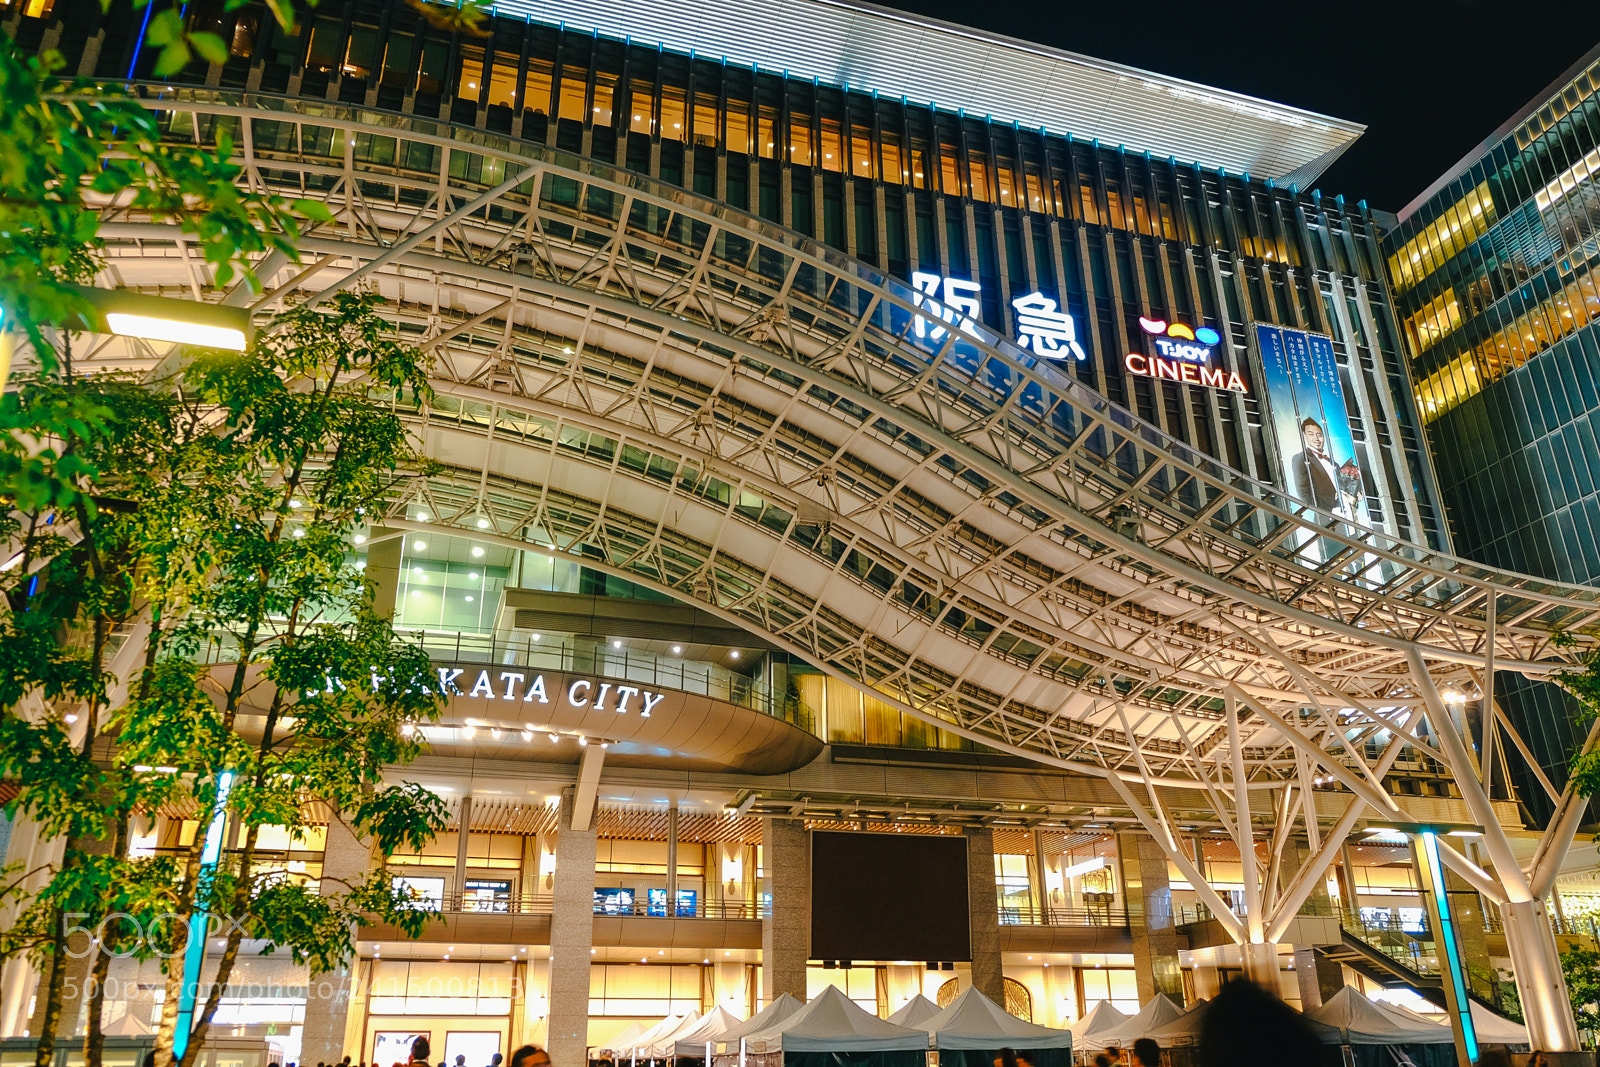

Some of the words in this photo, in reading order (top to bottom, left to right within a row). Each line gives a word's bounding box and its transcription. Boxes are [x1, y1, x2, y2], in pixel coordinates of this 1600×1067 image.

[912, 271, 1086, 361] 阪急
[1125, 353, 1248, 394] CINEMA
[568, 680, 665, 718] CITY
